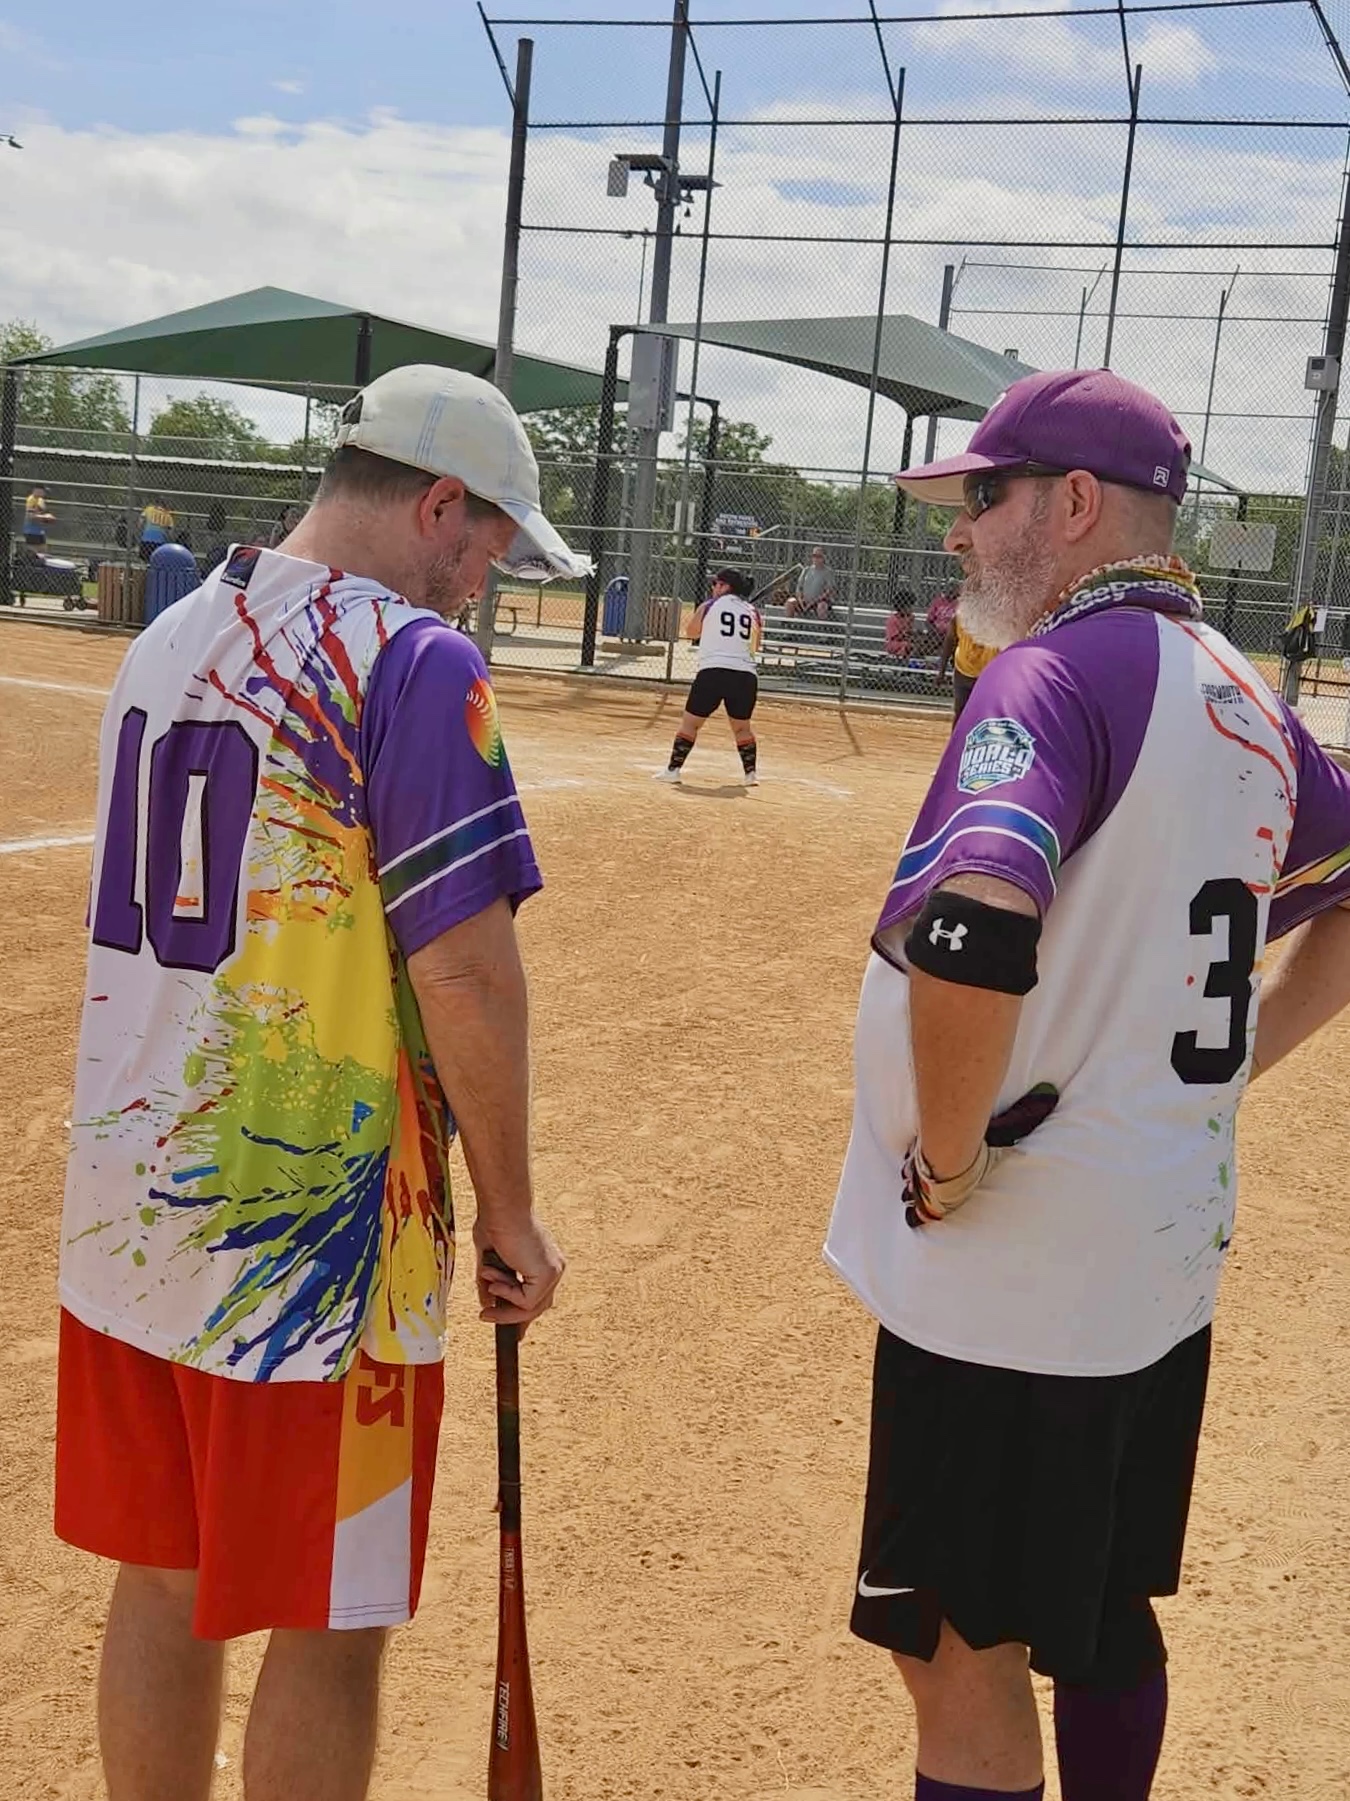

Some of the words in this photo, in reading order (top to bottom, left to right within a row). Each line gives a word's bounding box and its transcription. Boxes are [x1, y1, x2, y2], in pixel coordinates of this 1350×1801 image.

[720, 611, 752, 640] 99
[962, 760, 1013, 779] SERIES
[93, 706, 259, 974] 10
[1170, 878, 1258, 1084] 3
